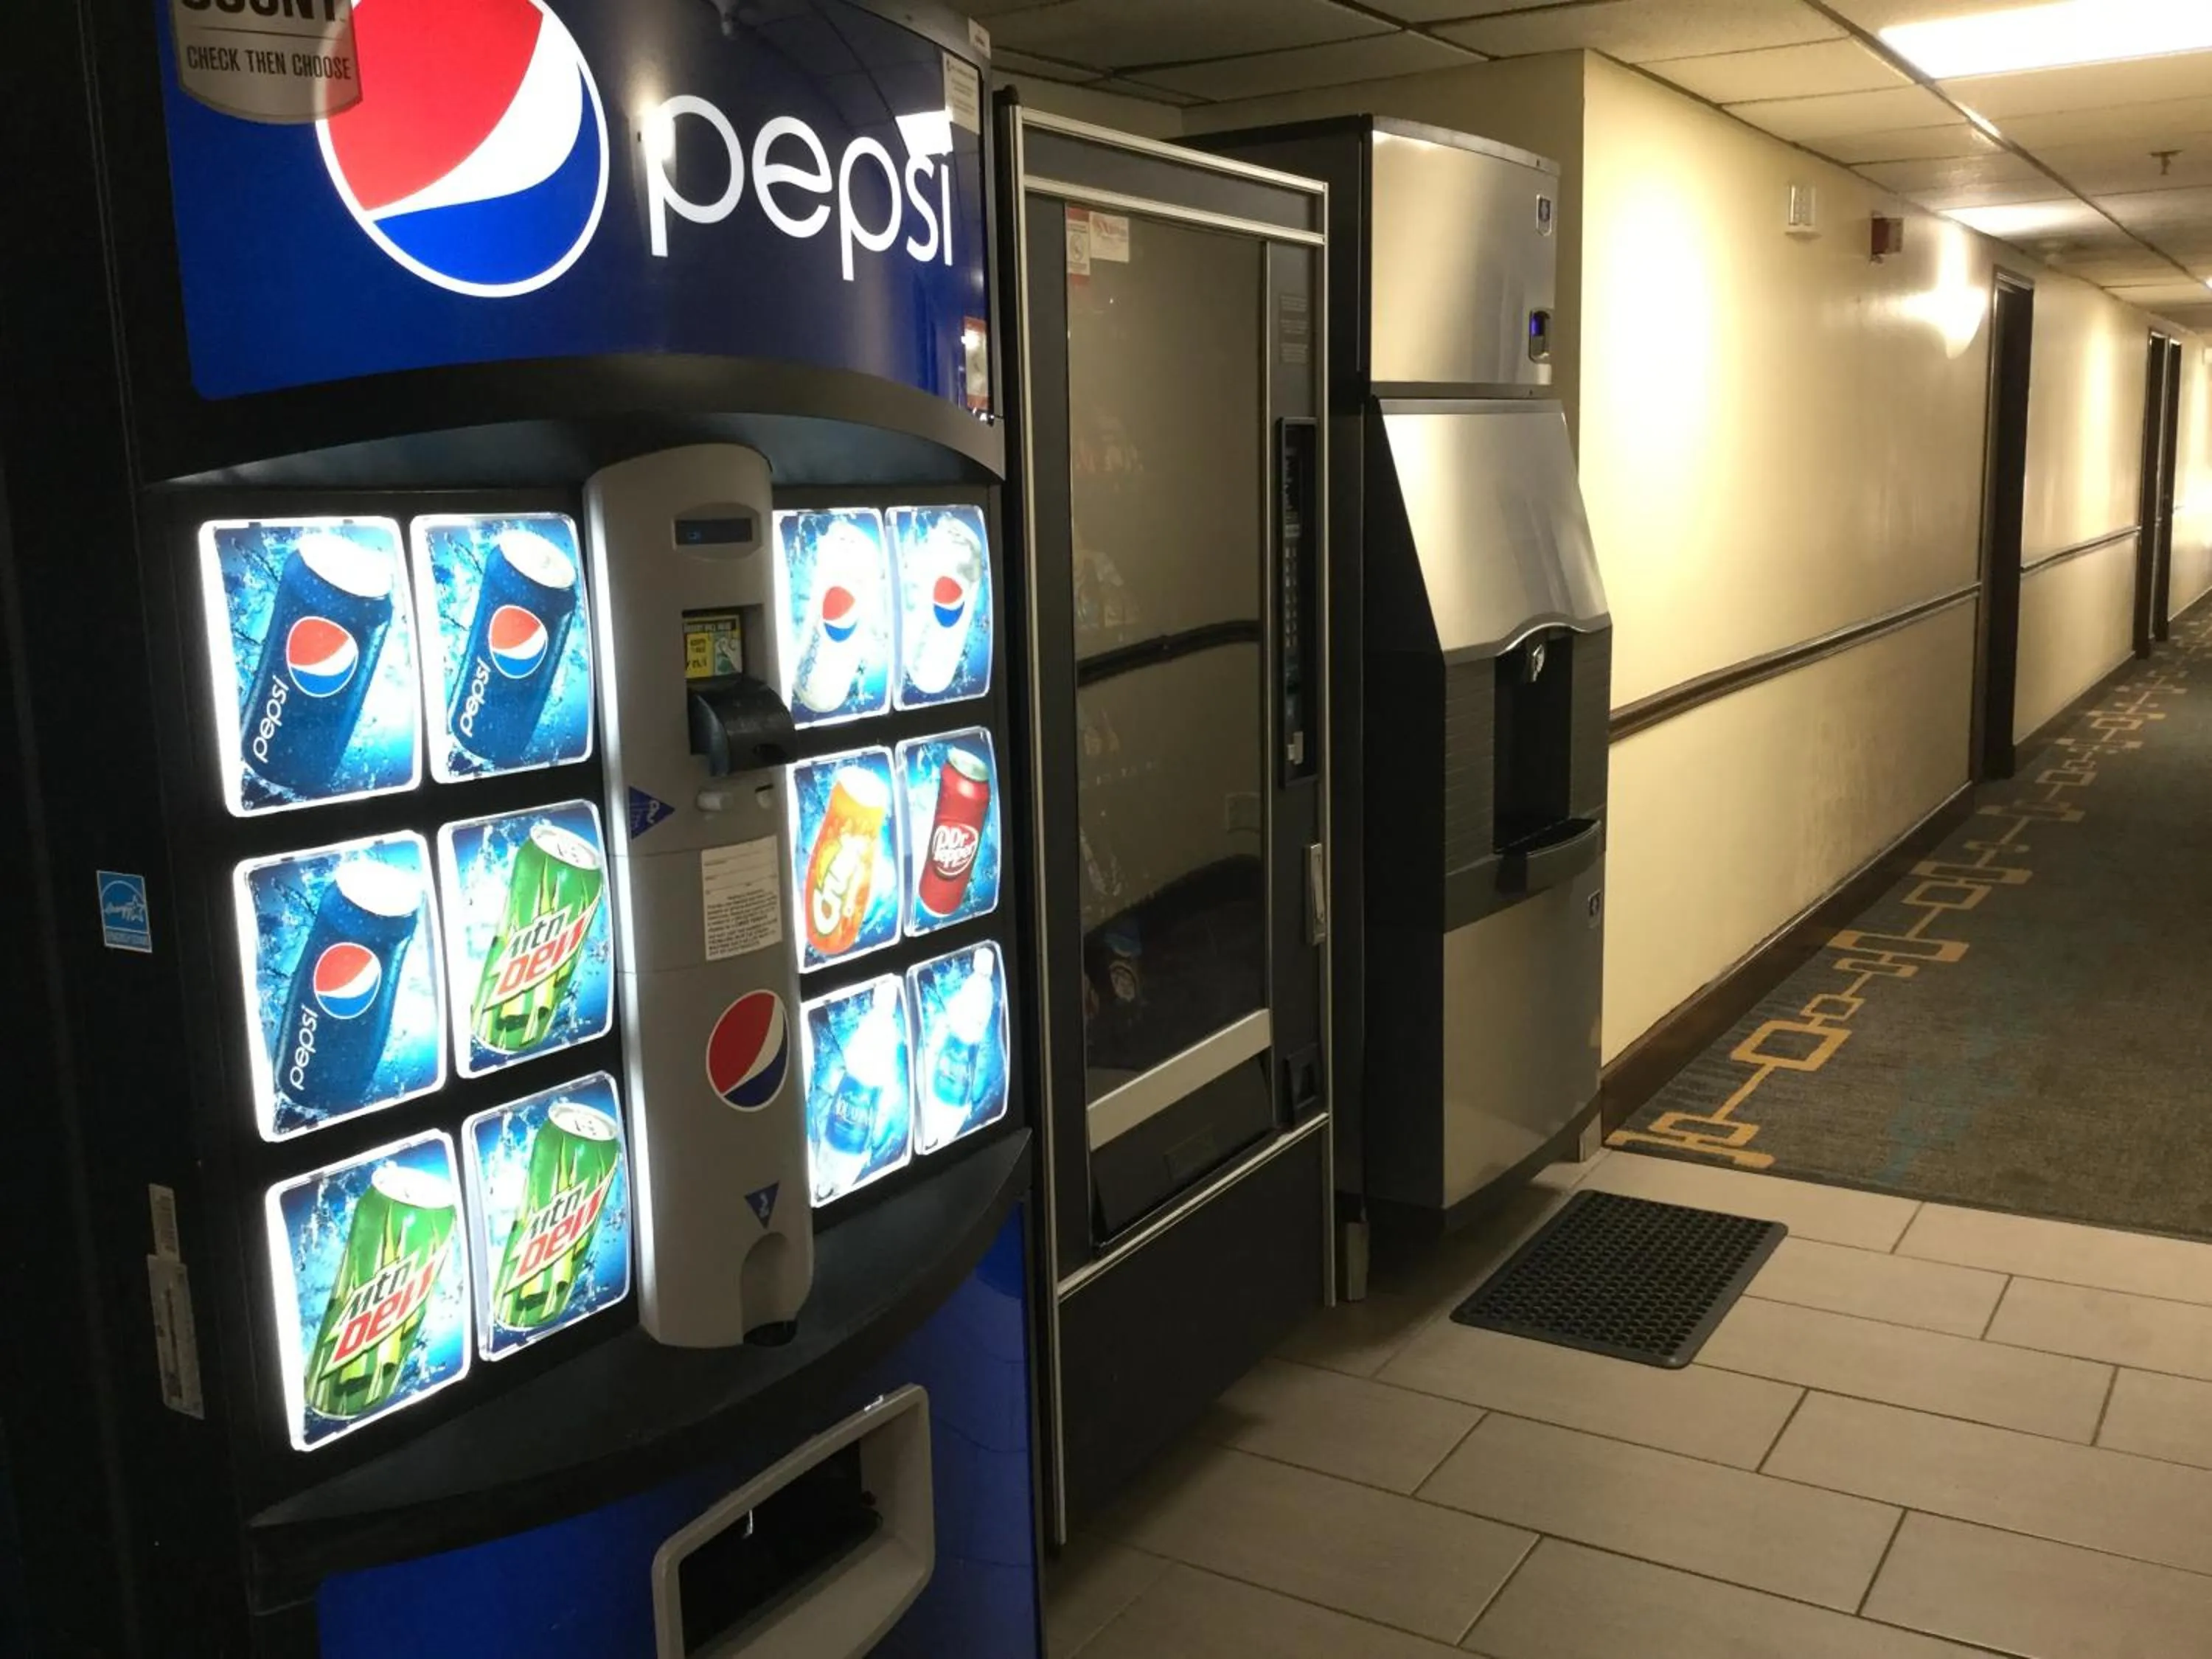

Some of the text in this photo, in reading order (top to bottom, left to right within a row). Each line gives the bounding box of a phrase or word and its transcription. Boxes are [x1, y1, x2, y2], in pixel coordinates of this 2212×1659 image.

[187, 45, 352, 80] CHECK THEN CHOOSE
[643, 94, 953, 281] pepsi
[253, 675, 290, 764] pepsi
[459, 657, 492, 738] pepsi
[290, 1004, 318, 1091] pepsi
